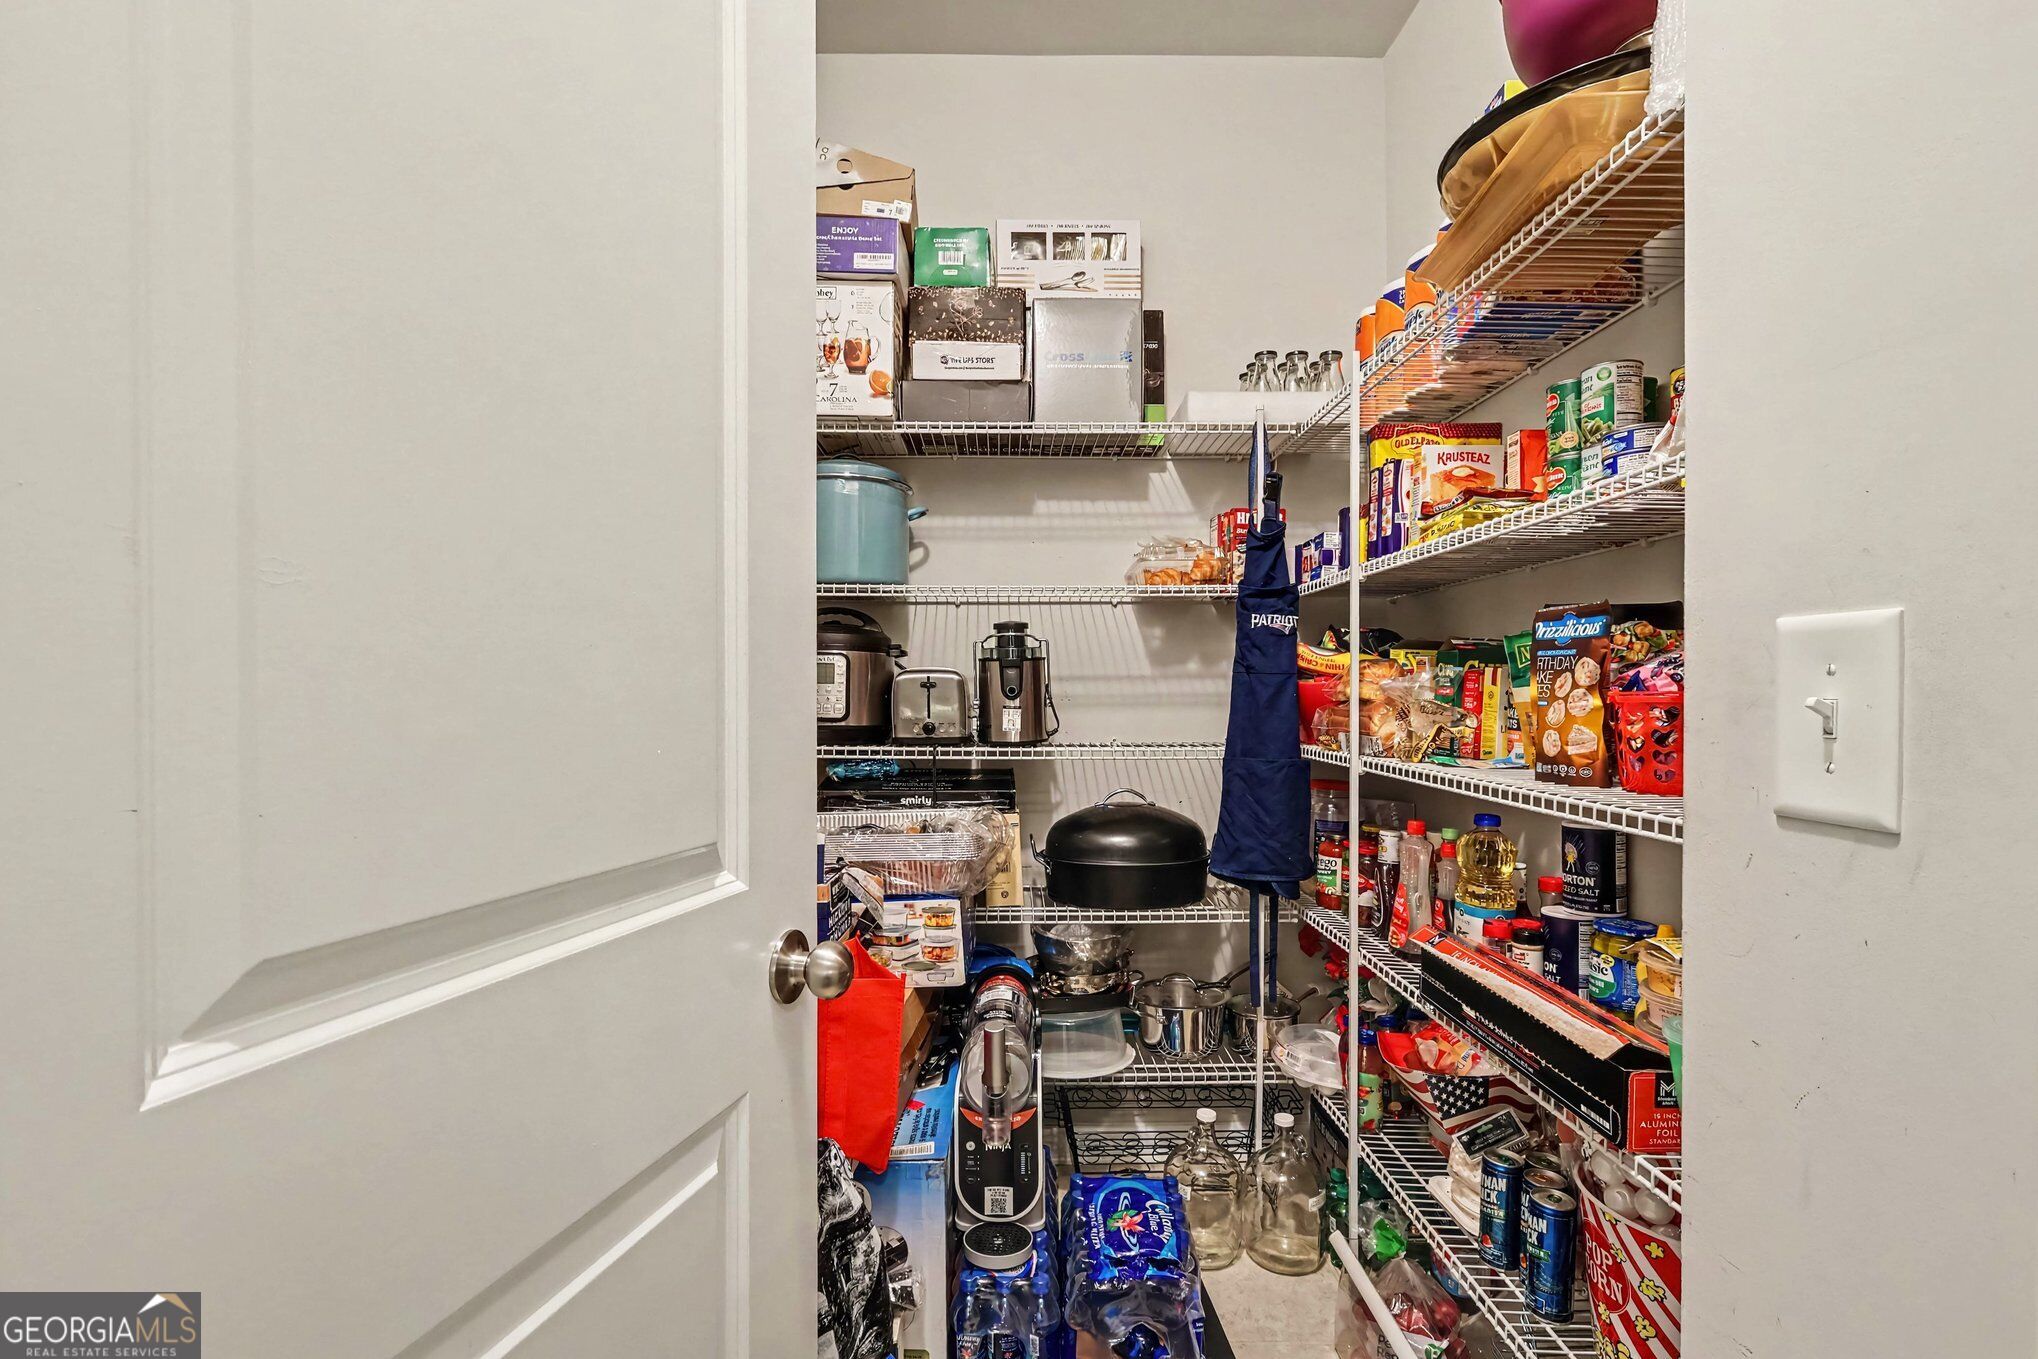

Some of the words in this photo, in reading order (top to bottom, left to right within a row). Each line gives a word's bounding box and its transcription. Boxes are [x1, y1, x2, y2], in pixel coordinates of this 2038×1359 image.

[831, 226, 859, 235] ENJOY
[829, 382, 839, 397] 7
[1437, 451, 1491, 466] KRUSTEAZ
[1251, 613, 1300, 629] PATRIOT
[1536, 656, 1579, 670] RTHDAY
[1536, 671, 1554, 684] AKE
[900, 795, 932, 806] smirly
[1562, 873, 1596, 887] ORTON
[1577, 888, 1600, 897] SALT
[1656, 1129, 1679, 1137] FOIL
[1584, 1230, 1613, 1273] POP
